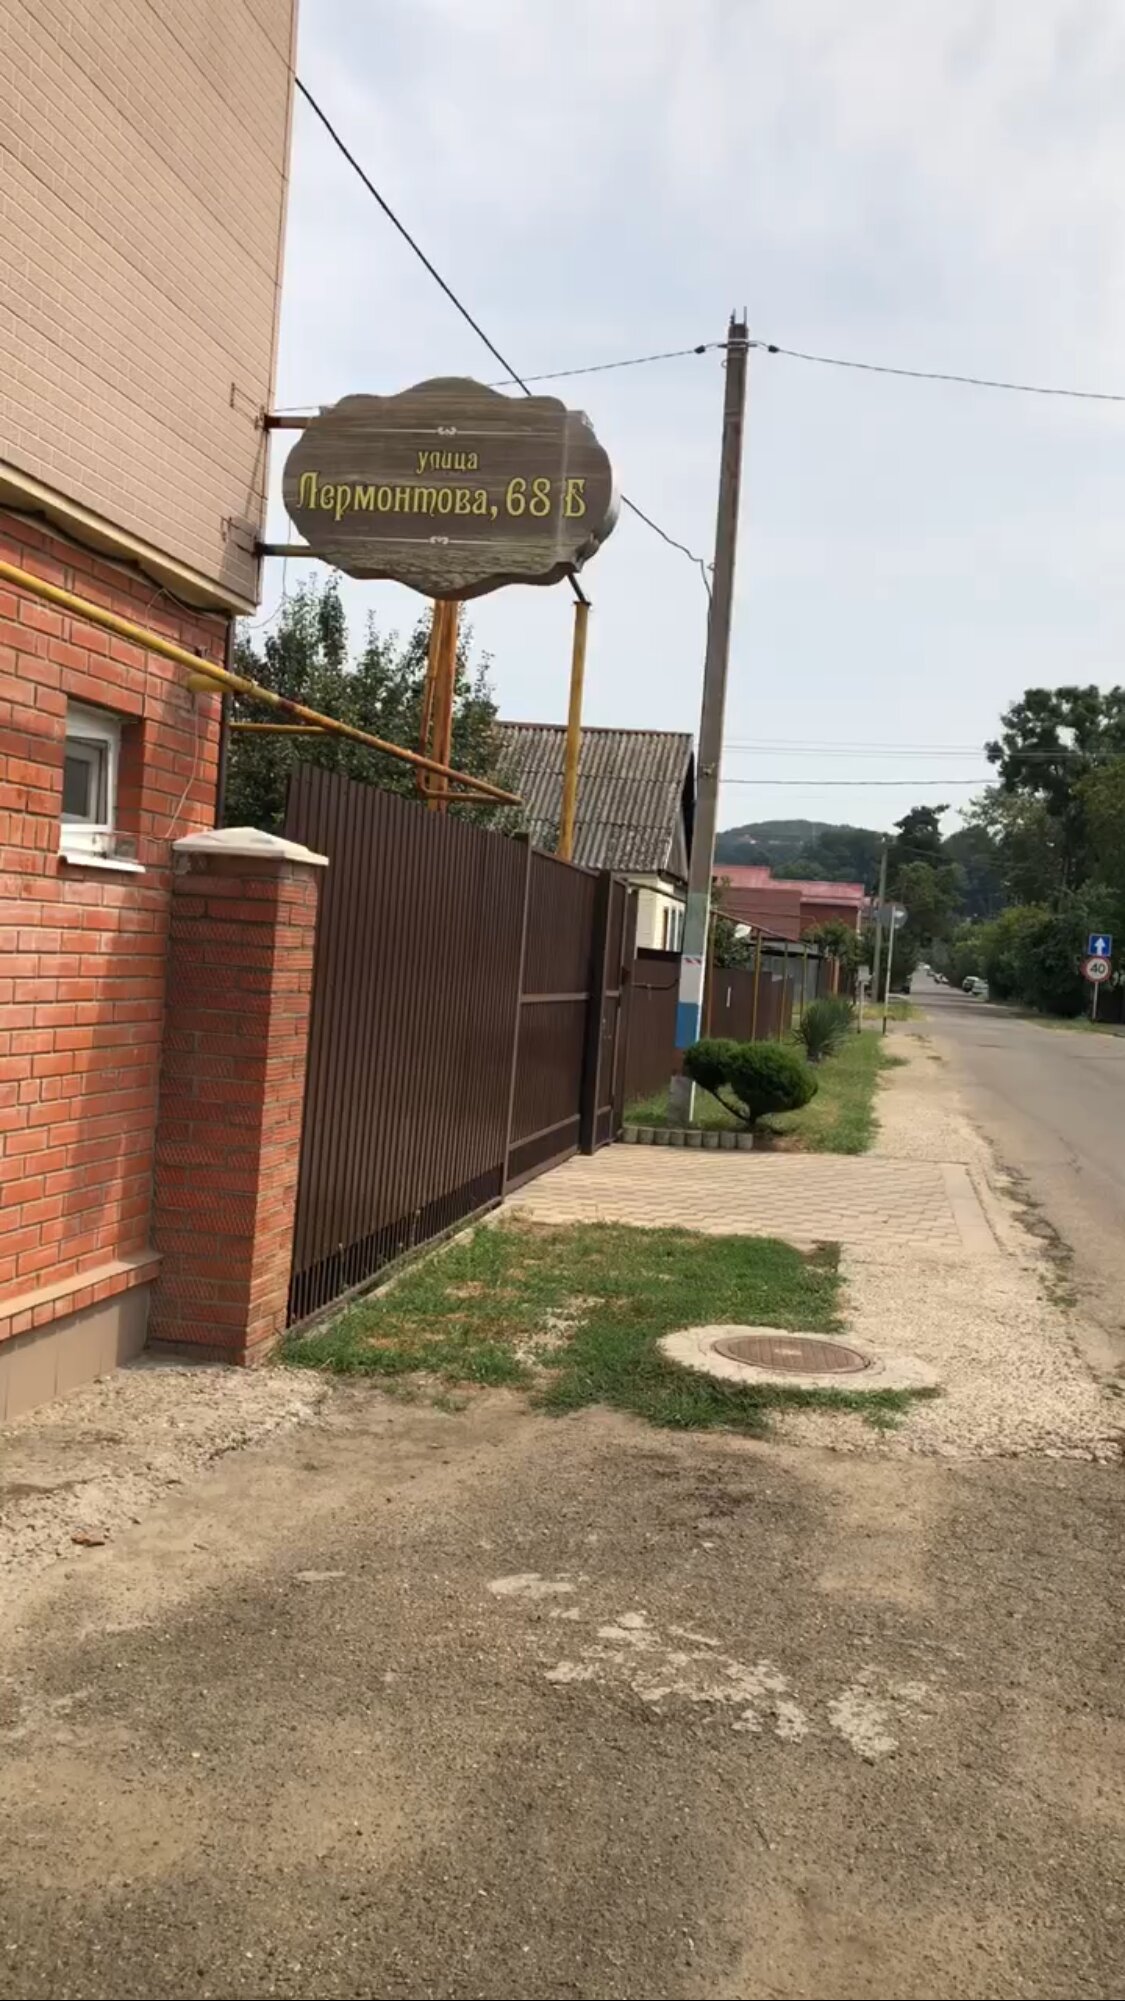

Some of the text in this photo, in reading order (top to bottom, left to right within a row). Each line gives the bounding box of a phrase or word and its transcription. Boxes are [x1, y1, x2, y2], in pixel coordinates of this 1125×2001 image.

[416, 451, 479, 474] улица
[297, 471, 587, 521] Лермонтова, 68 Б
[1089, 963, 1106, 974] 40
